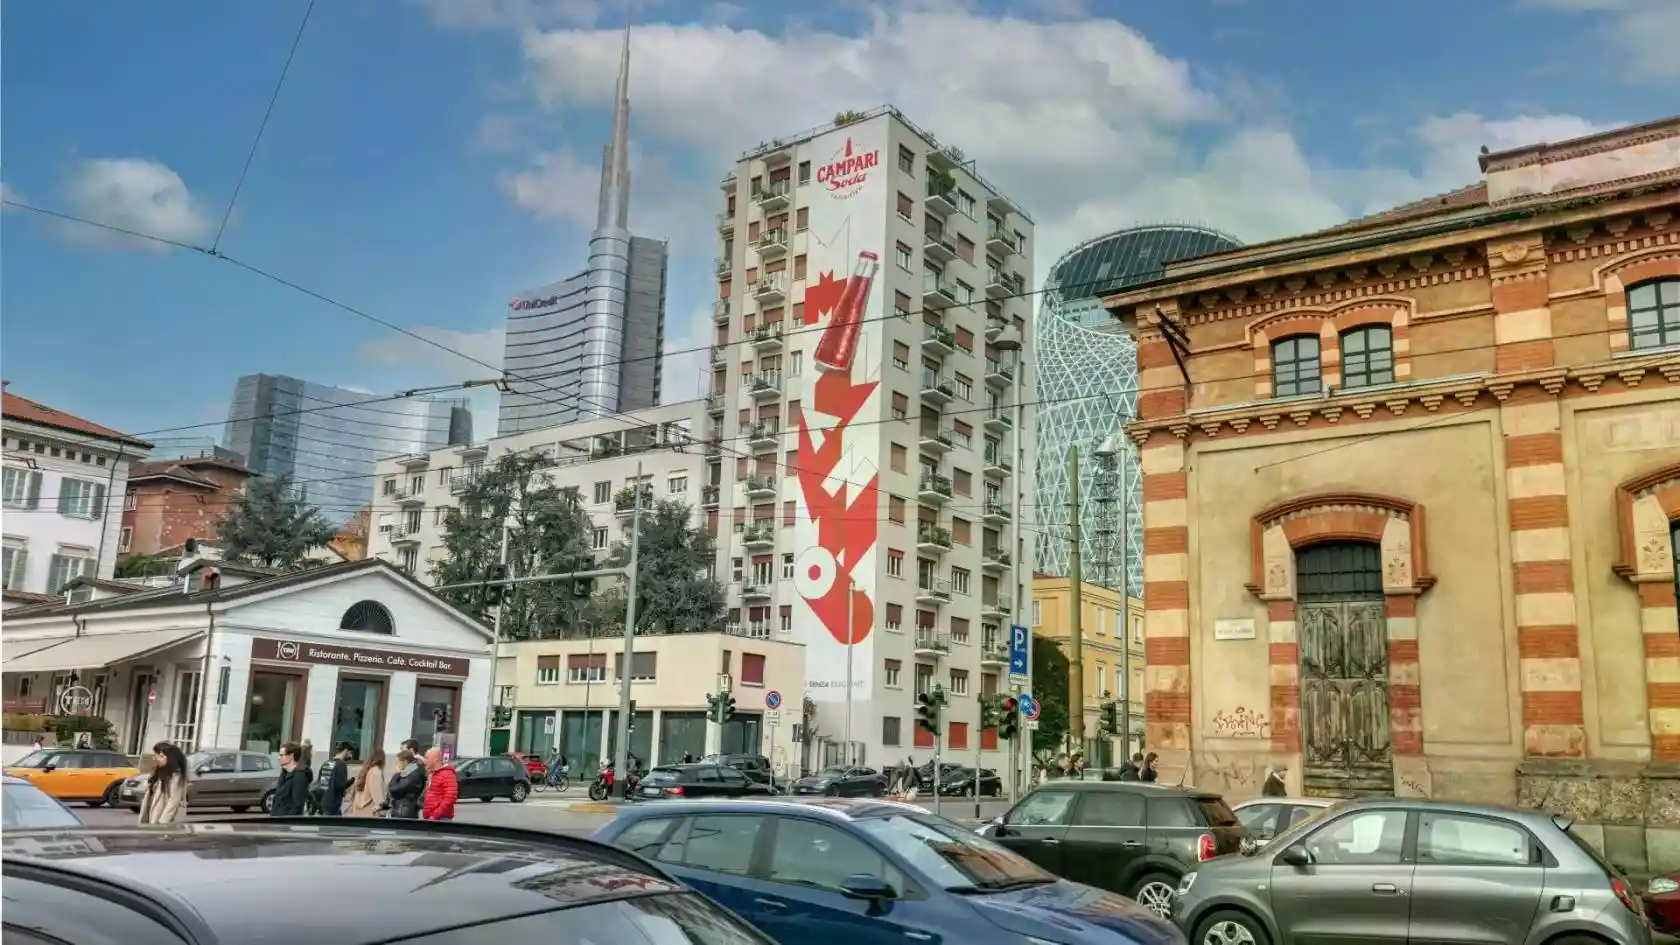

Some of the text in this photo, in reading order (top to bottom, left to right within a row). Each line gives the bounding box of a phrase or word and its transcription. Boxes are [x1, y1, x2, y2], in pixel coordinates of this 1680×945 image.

[816, 150, 879, 183] CAMPARI
[826, 172, 868, 191] Soda
[1014, 628, 1024, 652] P
[308, 647, 352, 661] Ristorante.
[353, 653, 385, 665] Pizzeria.
[408, 658, 438, 669] Cocktail
[438, 661, 453, 670] Bar.
